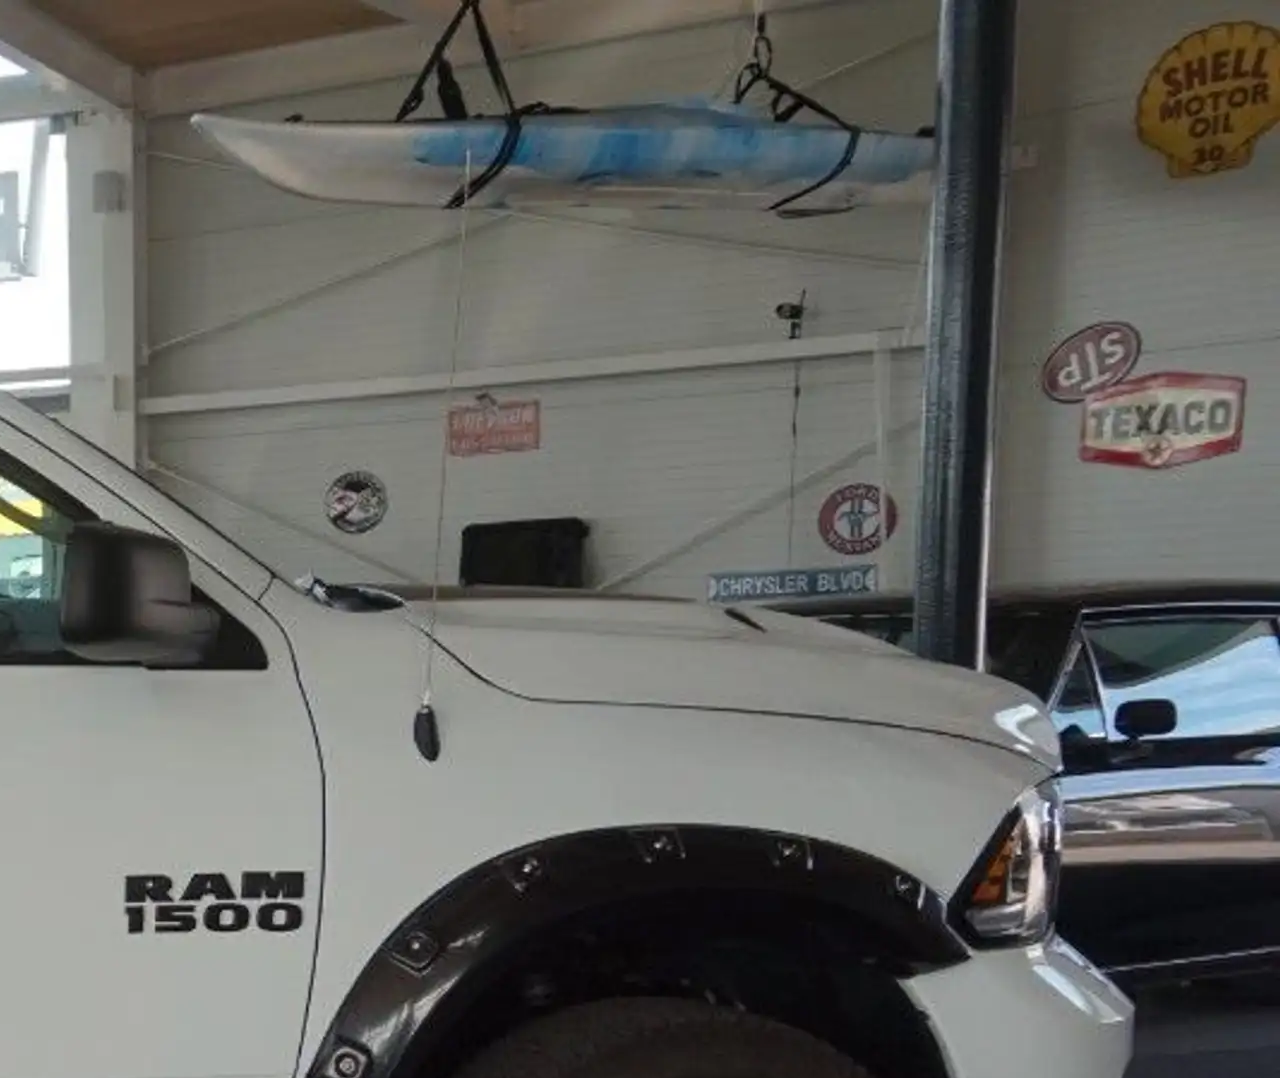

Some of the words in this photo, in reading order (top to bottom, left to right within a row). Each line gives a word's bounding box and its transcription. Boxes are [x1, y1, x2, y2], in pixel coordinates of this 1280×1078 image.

[1162, 47, 1269, 97] SHELL
[1159, 82, 1270, 123] MOTOR
[1188, 111, 1235, 139] OIL
[1058, 331, 1127, 392] STP
[1090, 399, 1233, 442] TEXACO
[719, 576, 809, 597] CHRYSLER
[816, 572, 864, 592] BLVD
[125, 871, 305, 902] RAM
[125, 902, 303, 934] 1500
